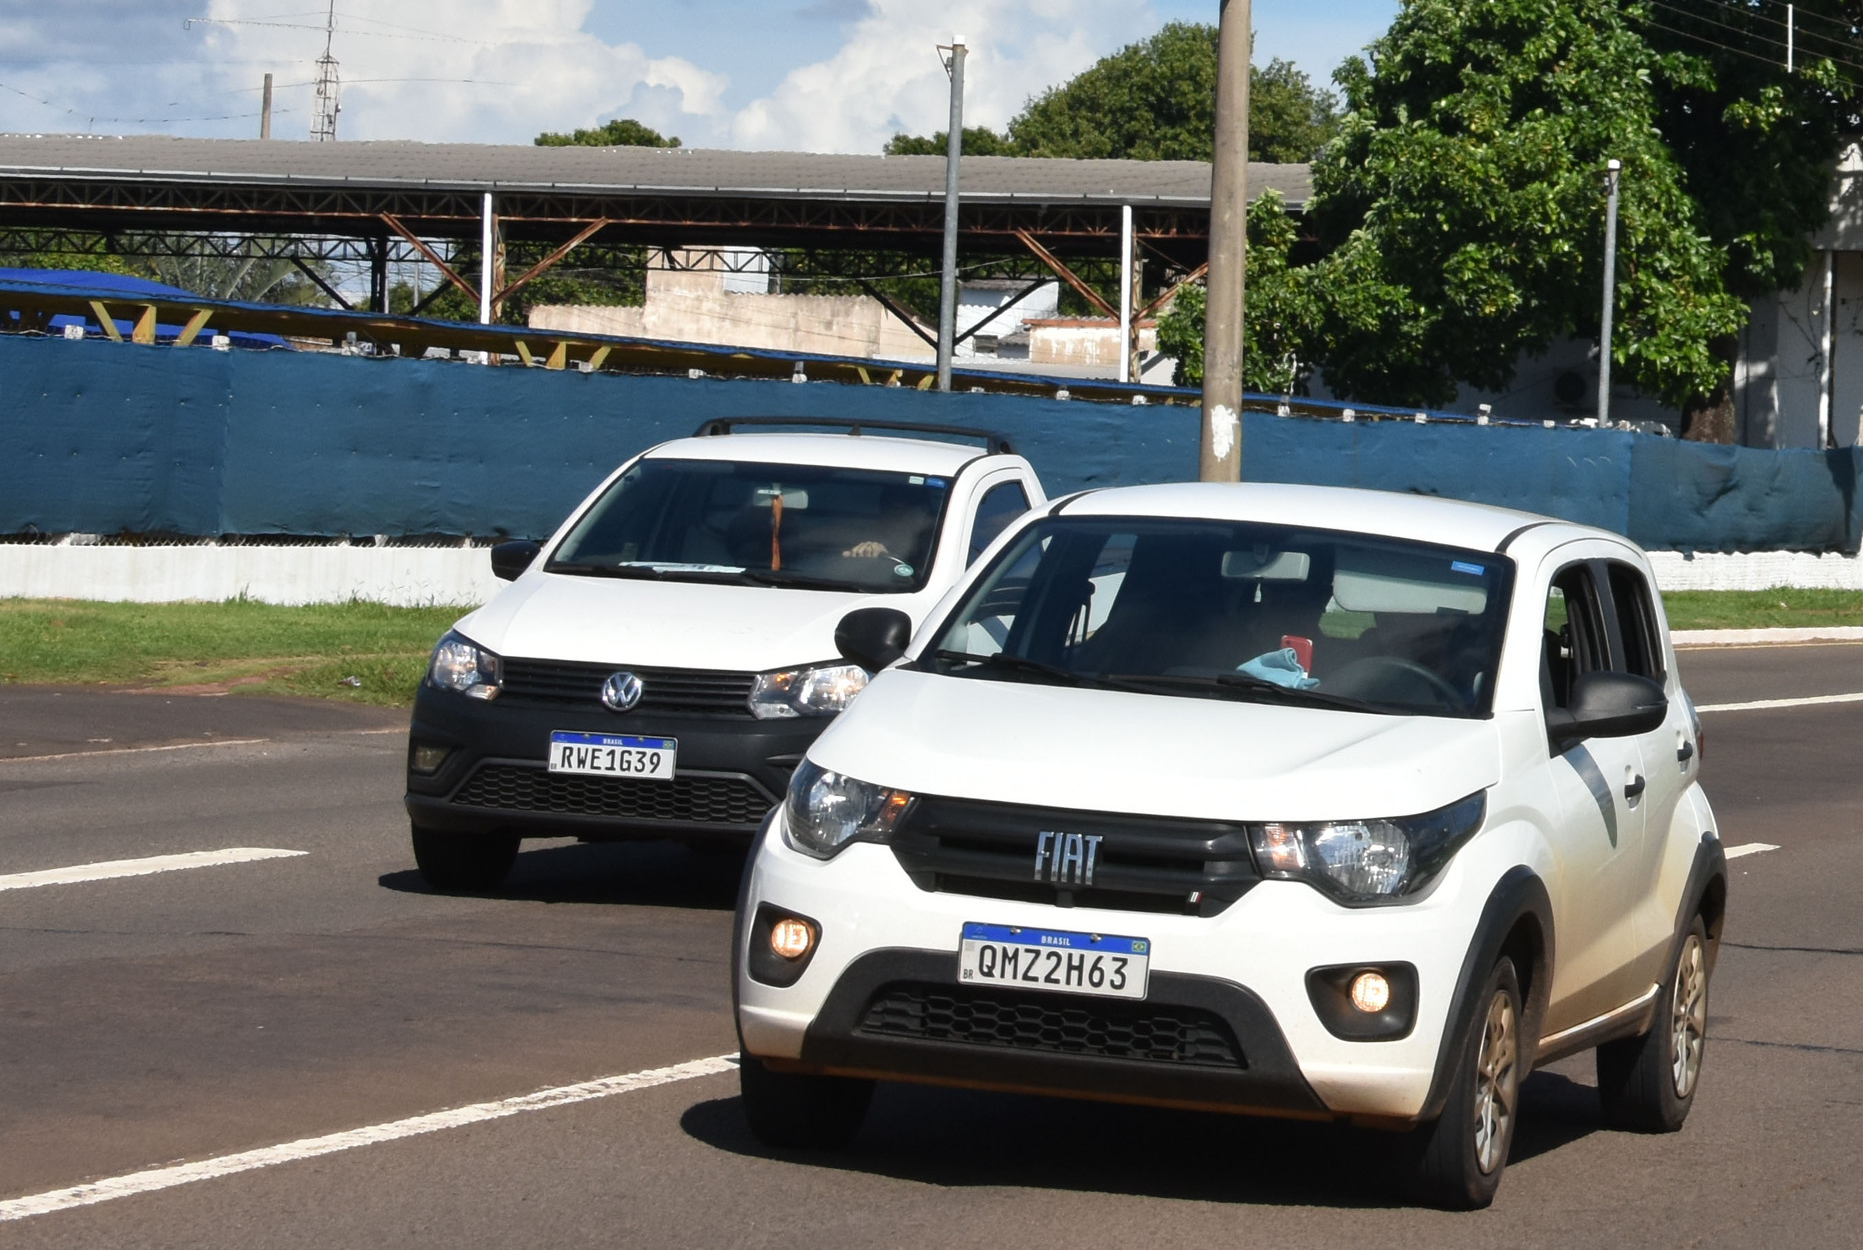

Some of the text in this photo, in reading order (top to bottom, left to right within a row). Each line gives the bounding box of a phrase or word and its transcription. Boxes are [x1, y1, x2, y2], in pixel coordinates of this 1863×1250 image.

[603, 738, 623, 746] BRASIL
[561, 746, 661, 774] RWE1G39
[1034, 831, 1103, 885] FIAT
[1041, 935, 1071, 946] BRASIL
[963, 969, 974, 980] BR
[978, 944, 1128, 990] QMZ2H63
